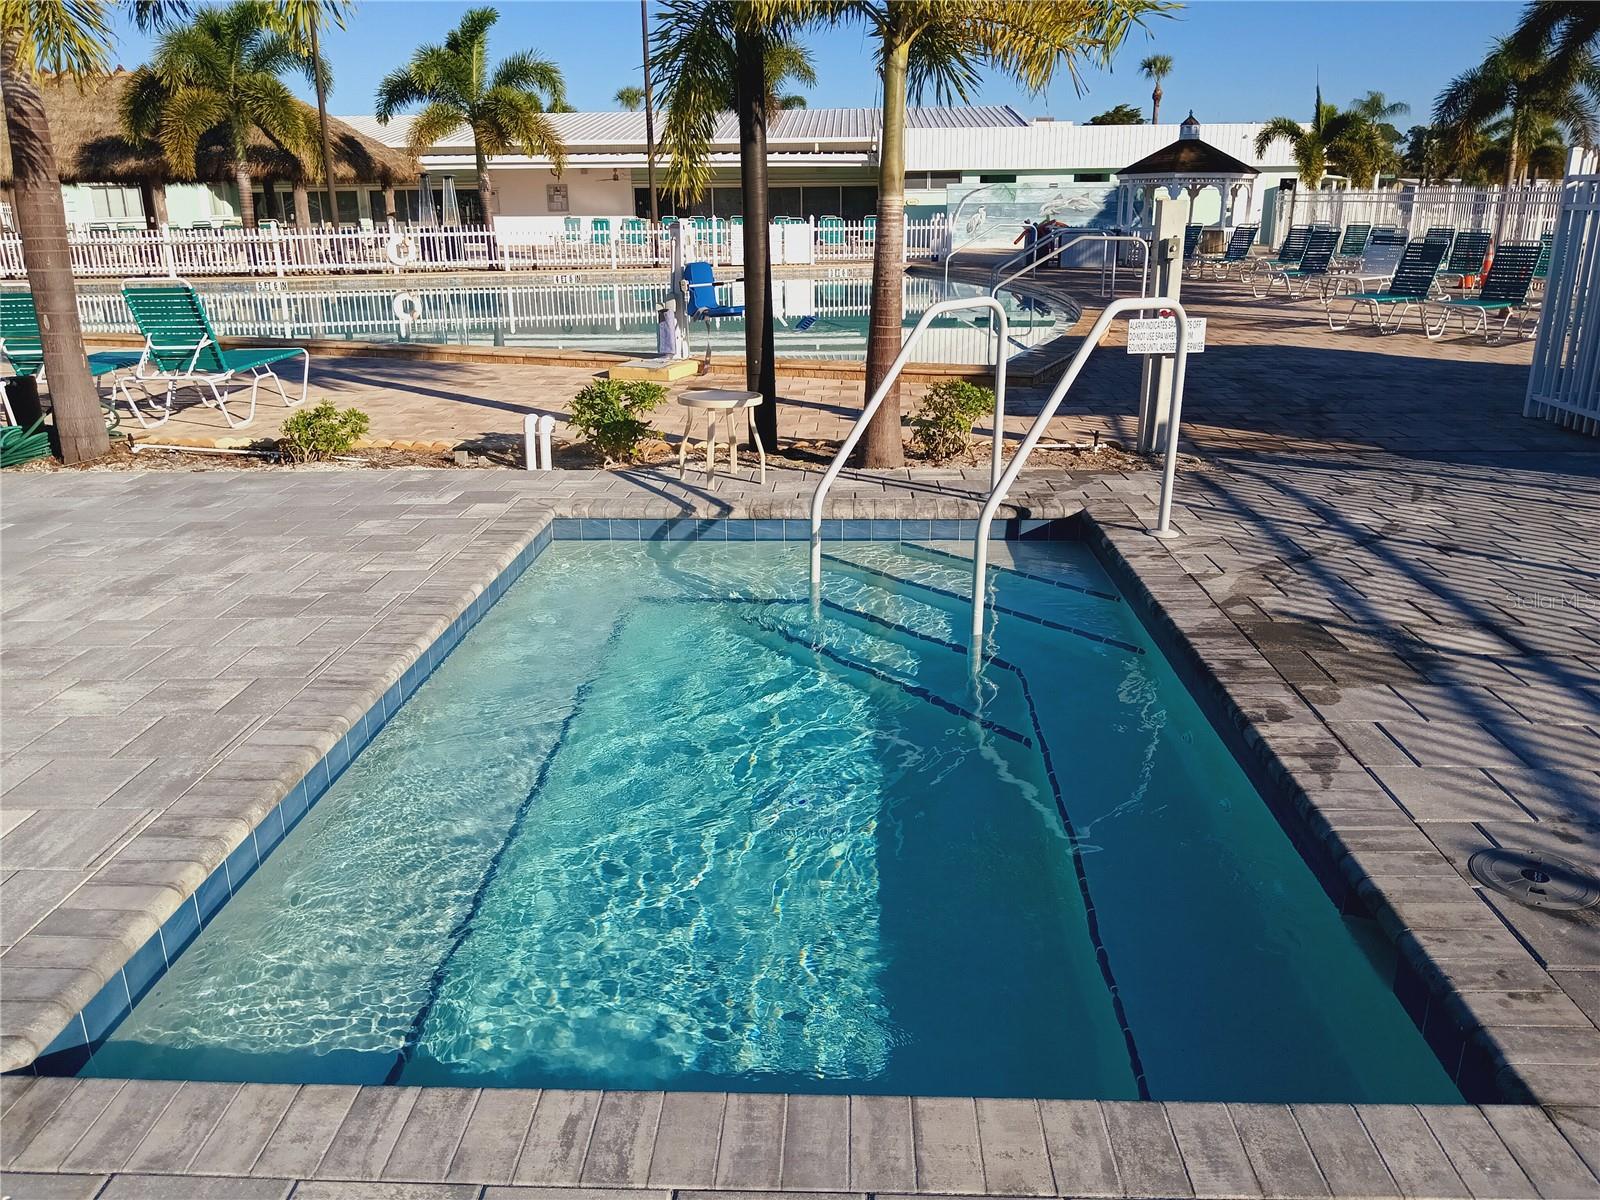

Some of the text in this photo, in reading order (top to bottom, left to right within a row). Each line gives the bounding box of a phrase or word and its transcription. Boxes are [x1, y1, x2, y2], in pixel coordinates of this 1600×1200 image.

[1129, 320, 1146, 330] ALARM
[1146, 320, 1168, 330] INDICATES
[1193, 319, 1202, 328] OFF
[1129, 332, 1136, 341] DO
[1136, 332, 1146, 341] NOT
[1147, 332, 1155, 341] USE
[1155, 331, 1164, 340] SPA
[1128, 343, 1147, 352] SOUNDS
[1147, 343, 1159, 352] UNTIL
